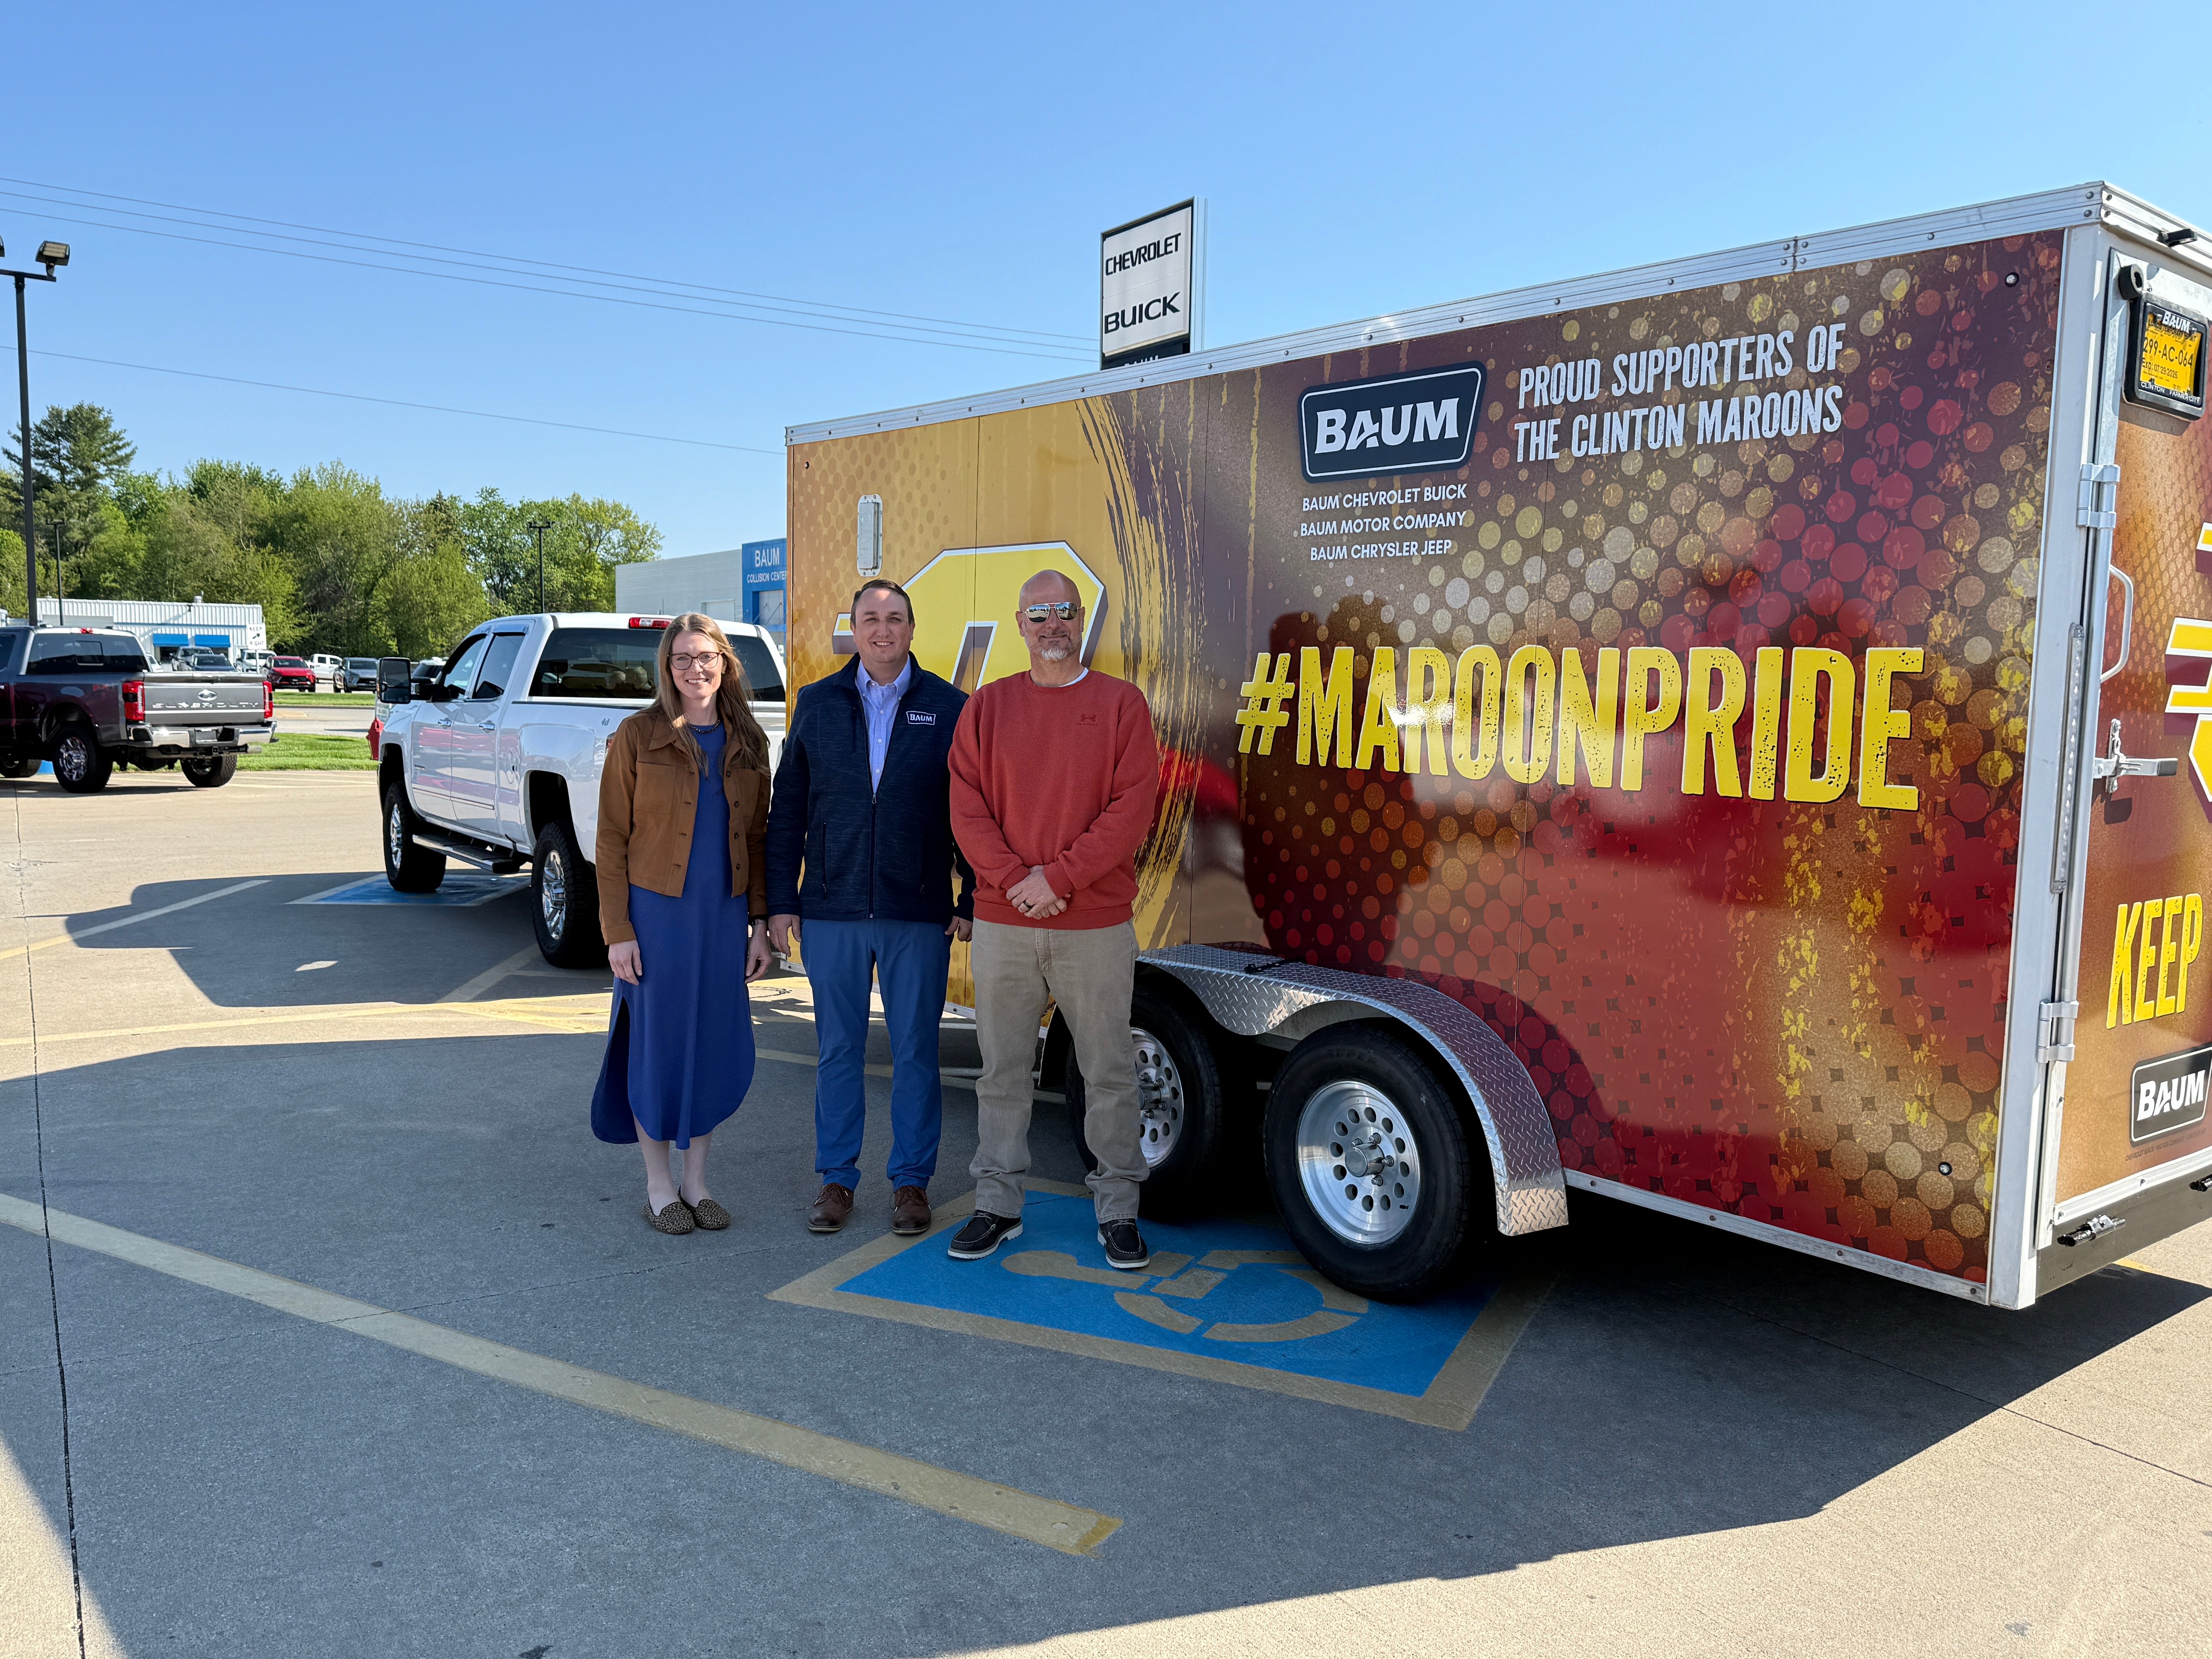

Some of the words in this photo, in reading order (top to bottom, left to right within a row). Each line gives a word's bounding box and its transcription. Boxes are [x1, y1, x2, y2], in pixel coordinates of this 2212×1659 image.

[1105, 232, 1181, 276] CHEVROLET
[1104, 291, 1180, 334] BUICK
[2162, 311, 2191, 334] BAUM
[1518, 358, 1601, 409] PROUD
[1611, 330, 1794, 397] SUPPORTERS
[1807, 323, 1846, 373] OF
[2141, 382, 2165, 393] CLINTON
[1314, 397, 1460, 454] BAUM
[1514, 419, 1559, 463] THE
[1571, 404, 1685, 457] CLINTON
[1697, 385, 1843, 445] MAROONS
[1302, 495, 1340, 511] BAUM
[1343, 488, 1420, 508] CHEVROLET
[1424, 483, 1468, 501] BUICK
[1300, 520, 1337, 536] BAUM
[1340, 517, 1389, 534] MOTOR
[1393, 511, 1467, 530] COMPANY
[755, 547, 780, 567] BAUM
[1310, 545, 1348, 561] BAUM
[1351, 541, 1419, 559] CHRYSLER
[1421, 539, 1452, 555] JEEP
[747, 572, 769, 583] COLLISION
[910, 714, 933, 722] BAUM
[1235, 644, 1925, 811] #MAROONPRIDE
[2106, 893, 2203, 1029] KEEP
[2136, 1070, 2206, 1121] BAUM
